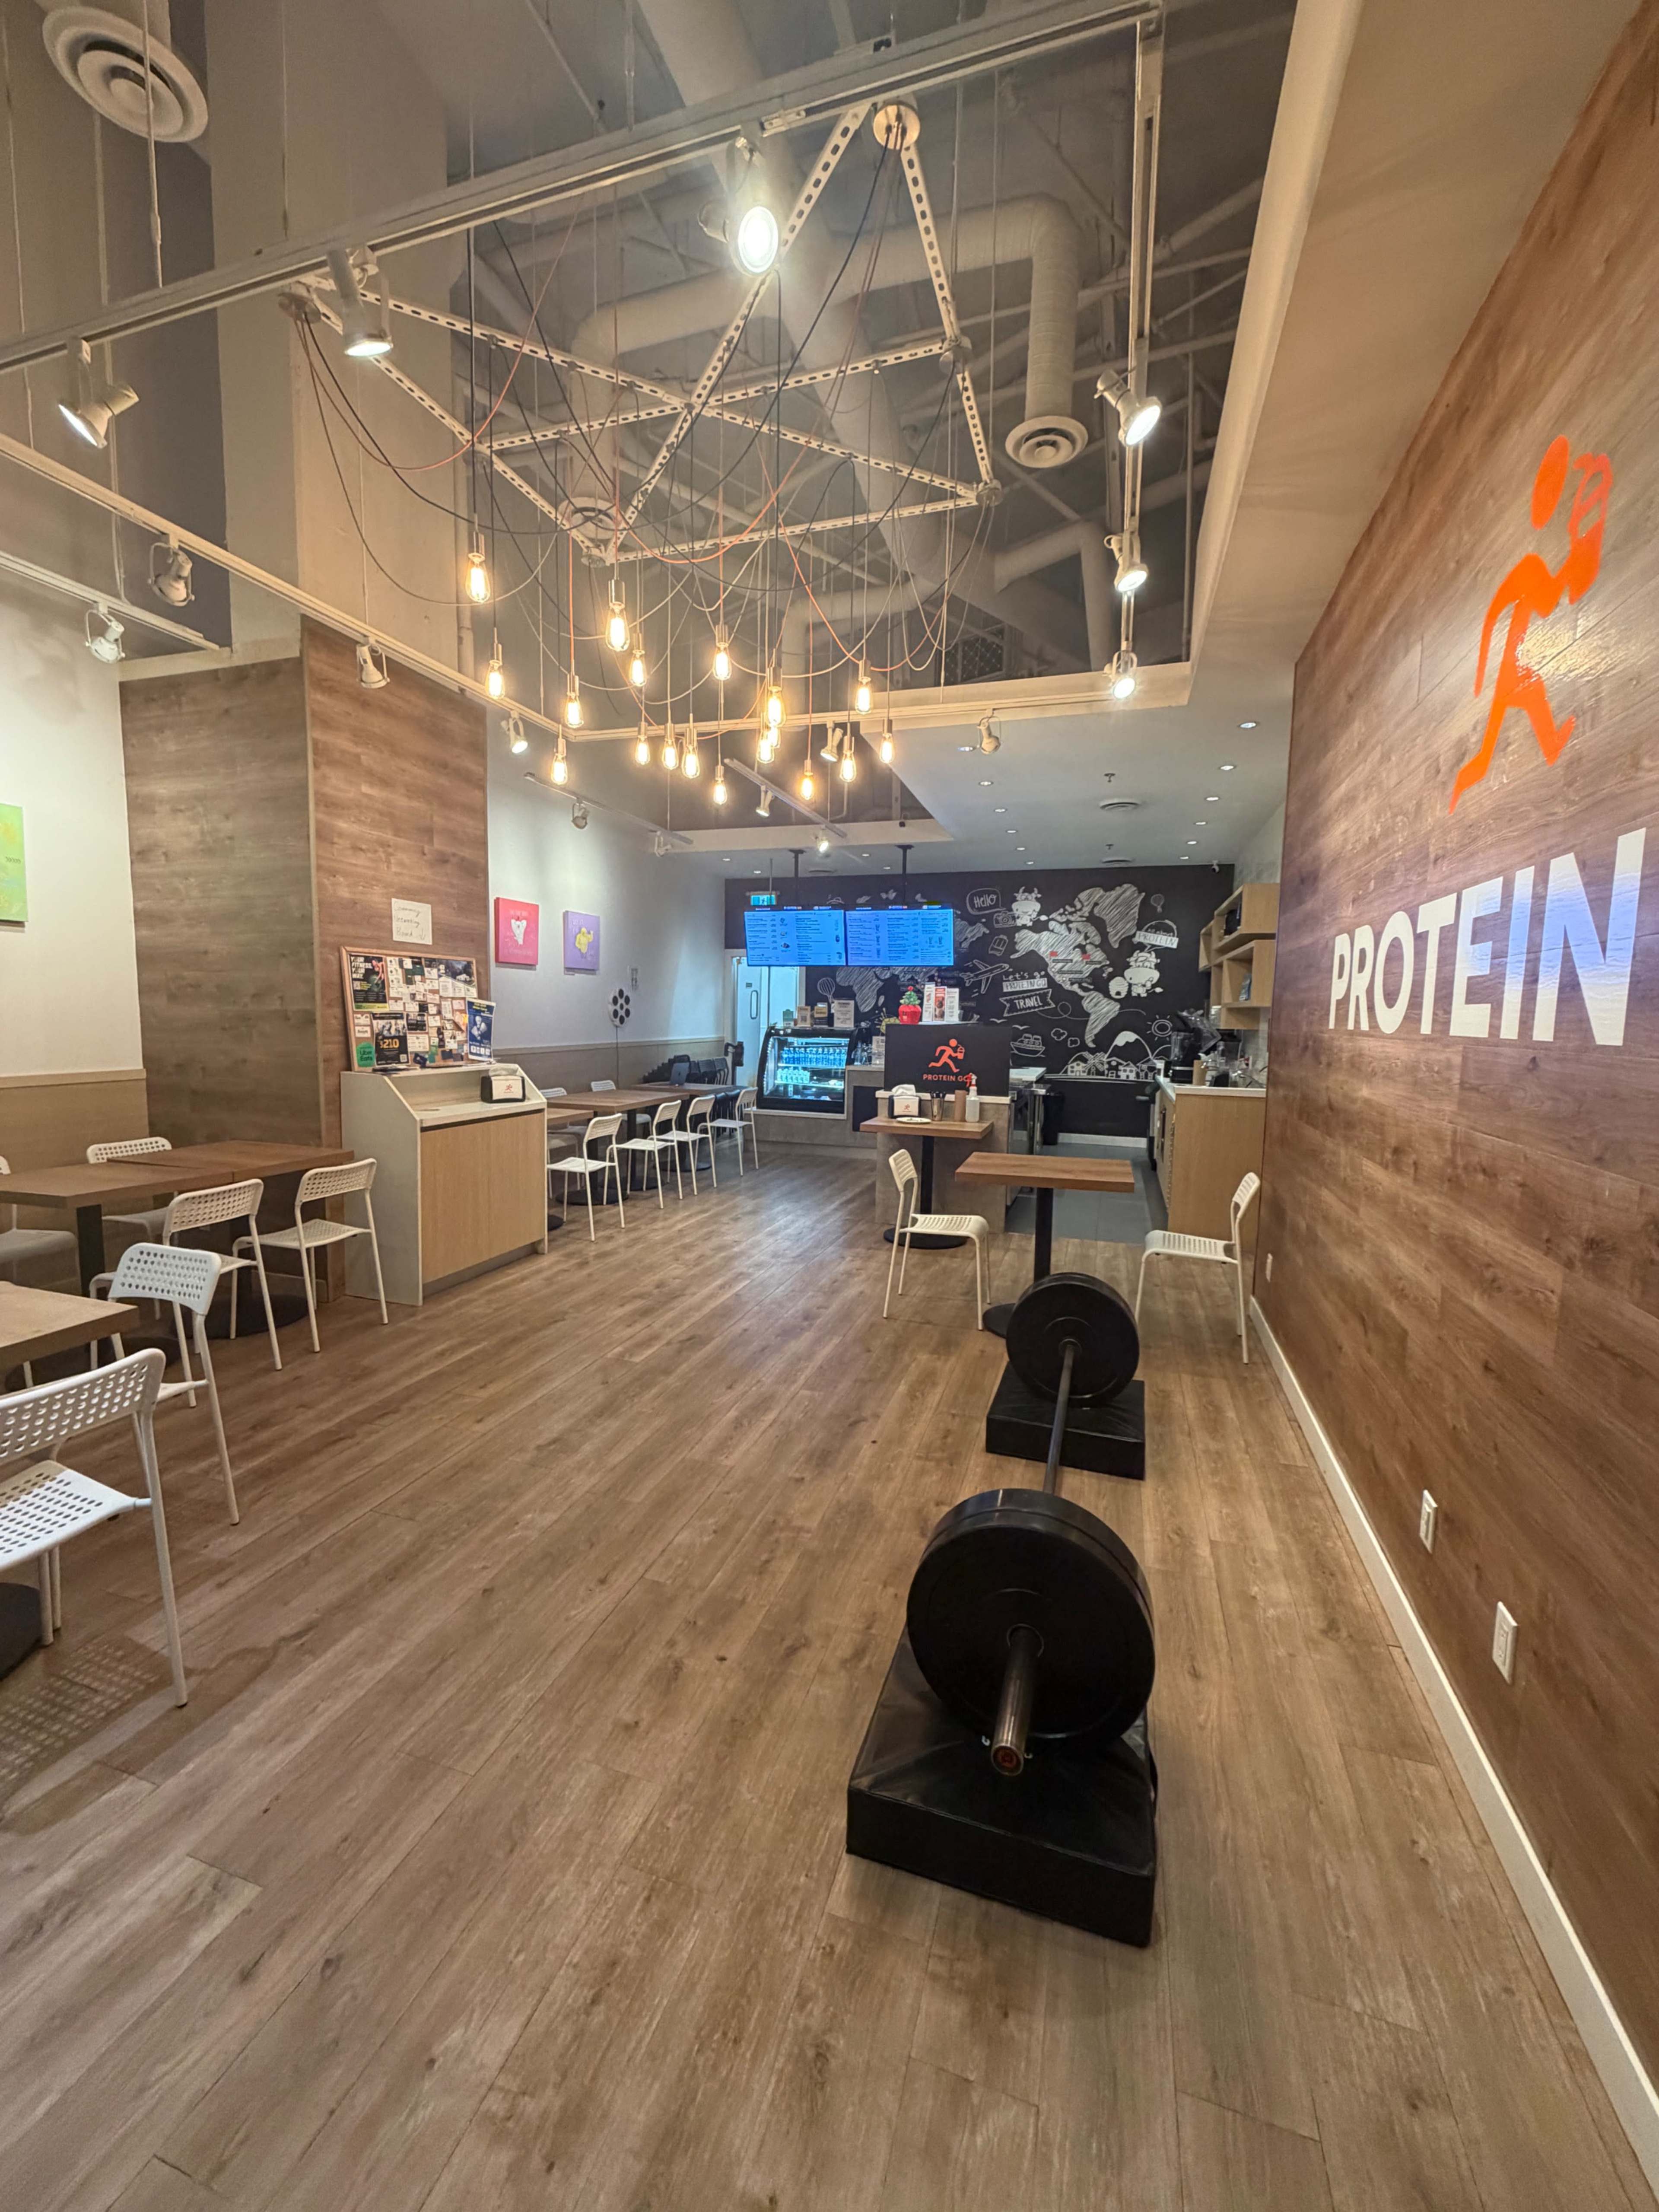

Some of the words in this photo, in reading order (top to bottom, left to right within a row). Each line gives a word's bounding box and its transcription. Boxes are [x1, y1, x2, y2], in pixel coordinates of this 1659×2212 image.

[973, 894, 997, 908] Hello
[1138, 933, 1176, 946] PROTEIN
[1328, 828, 1646, 1046] PROTEIN
[1002, 971, 1029, 981] Let's
[1033, 971, 1045, 980] go
[1014, 996, 1043, 1009] TRAVEL
